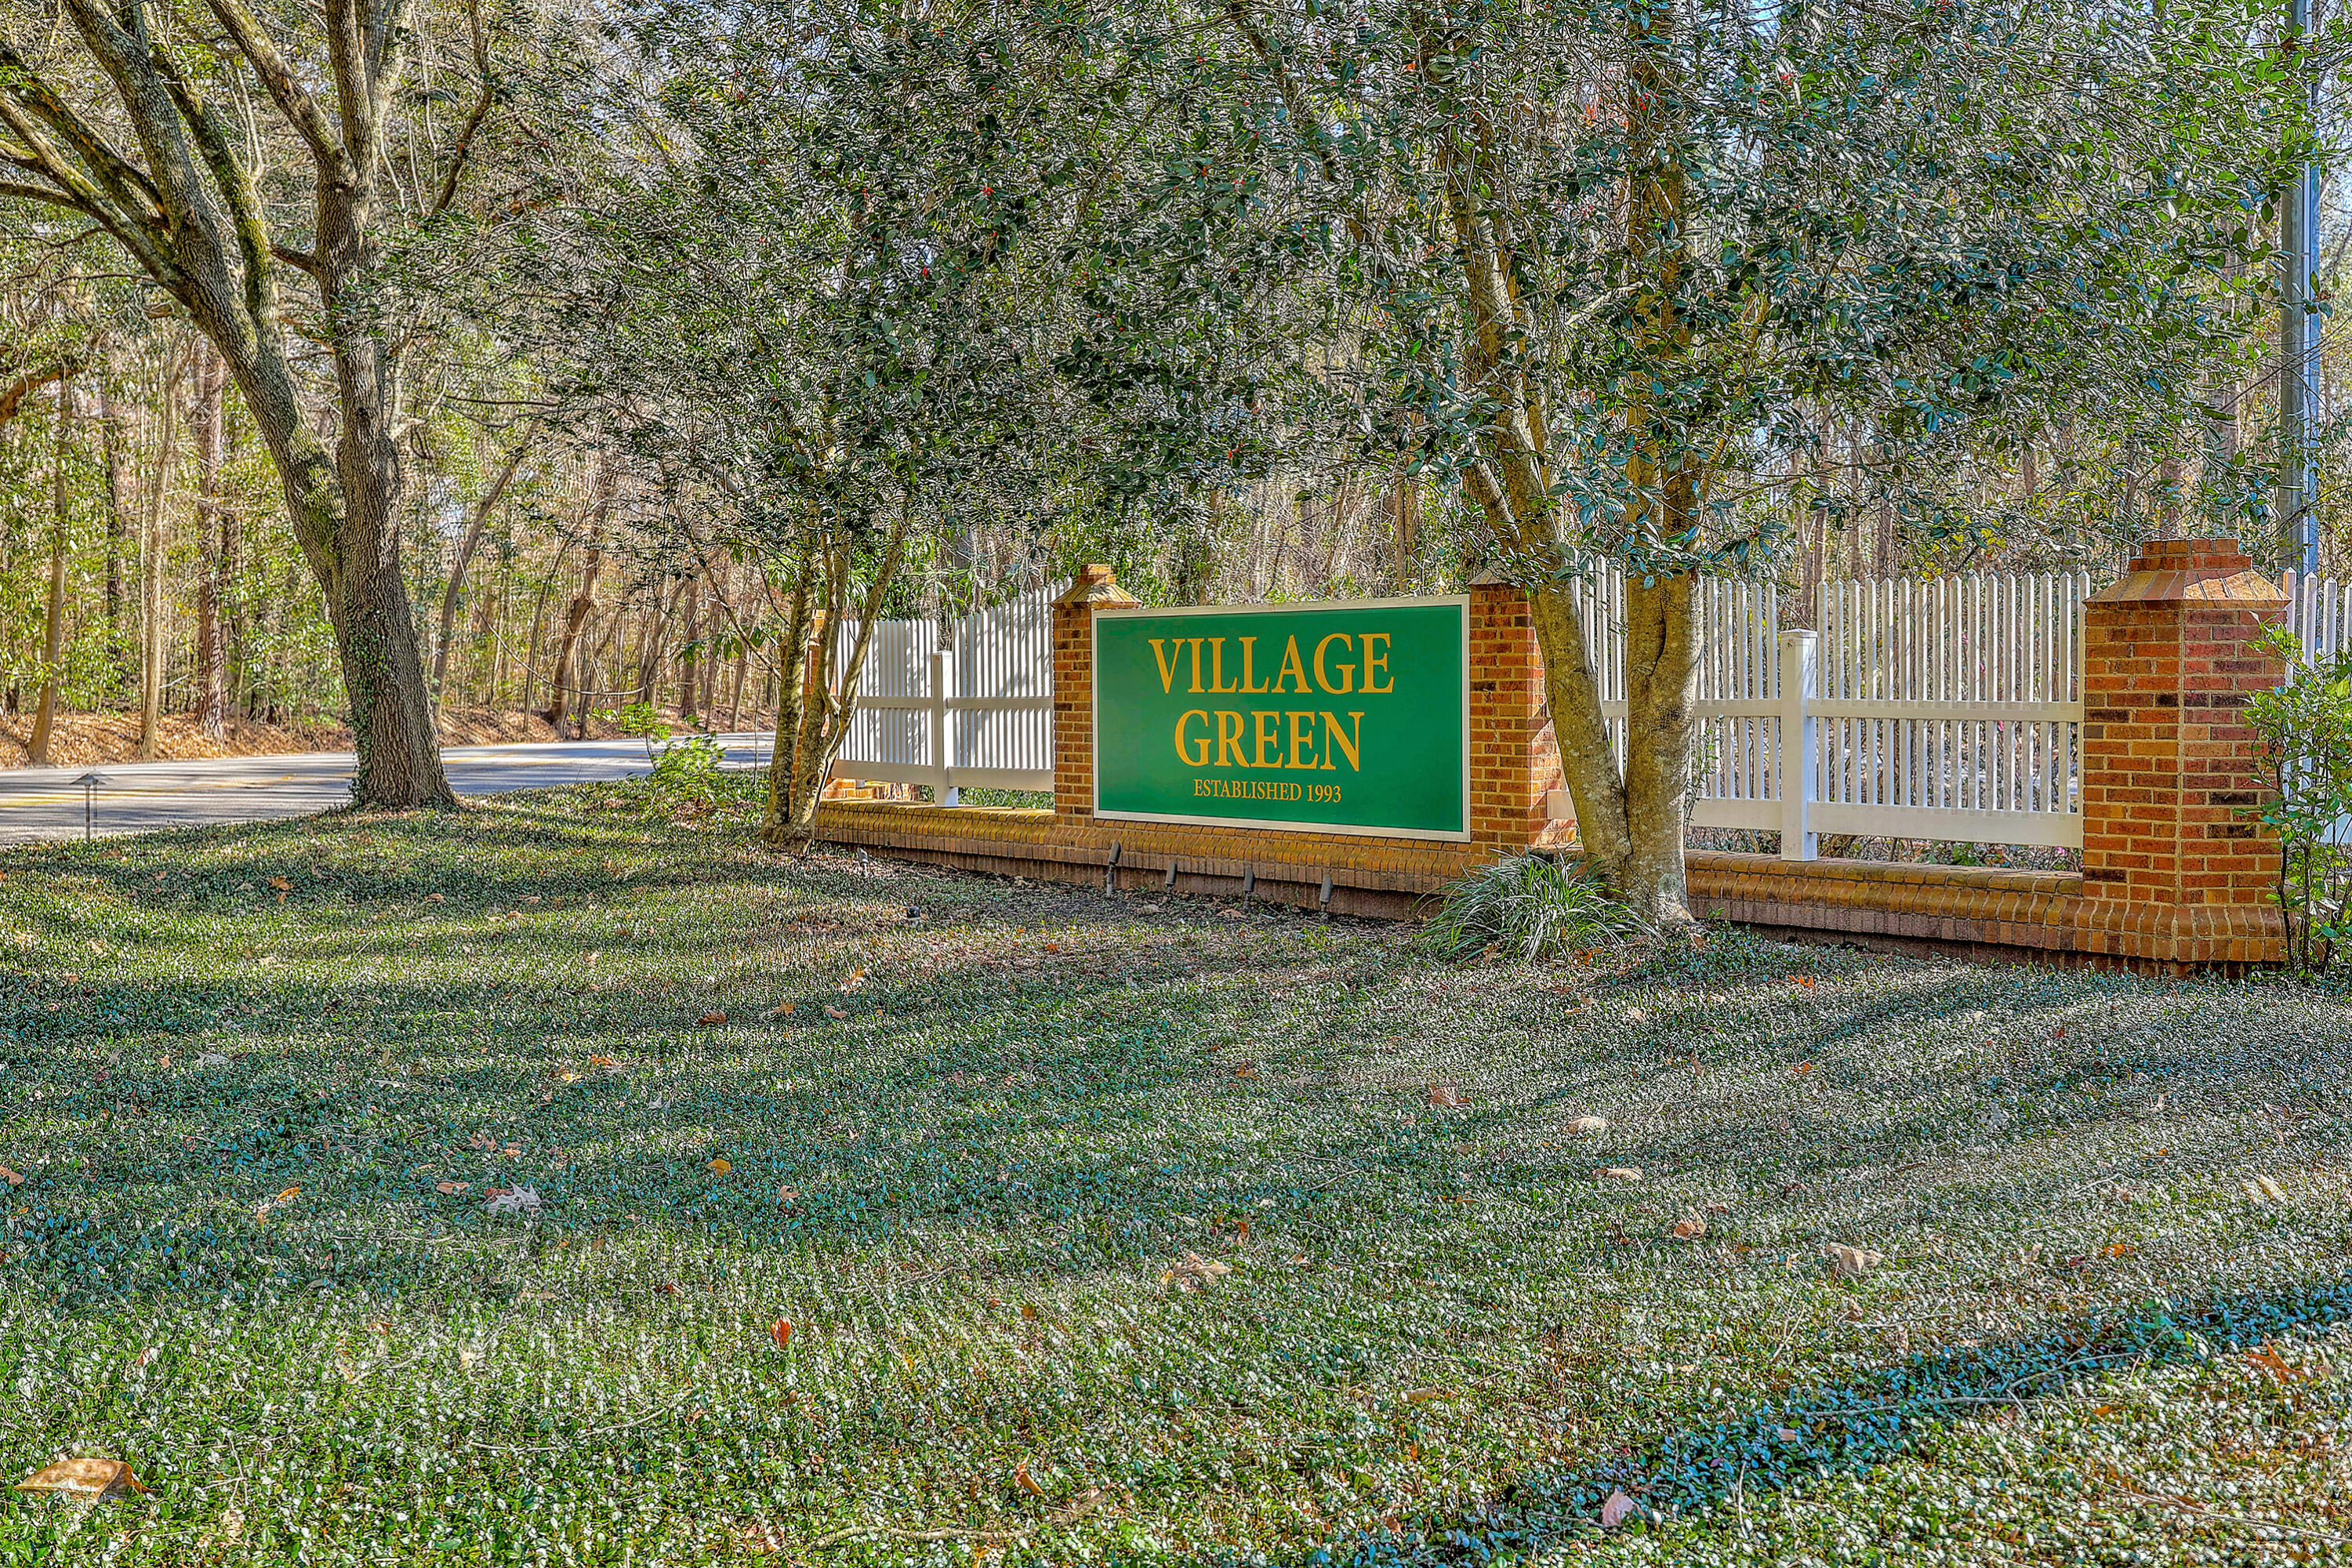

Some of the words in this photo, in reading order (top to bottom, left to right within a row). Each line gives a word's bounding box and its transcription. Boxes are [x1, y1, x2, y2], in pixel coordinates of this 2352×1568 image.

[1148, 633, 1395, 695] VILLAGE
[1174, 709, 1365, 772] GREEN
[1193, 779, 1302, 801] ESTABLISHED
[1307, 784, 1341, 804] 1993
